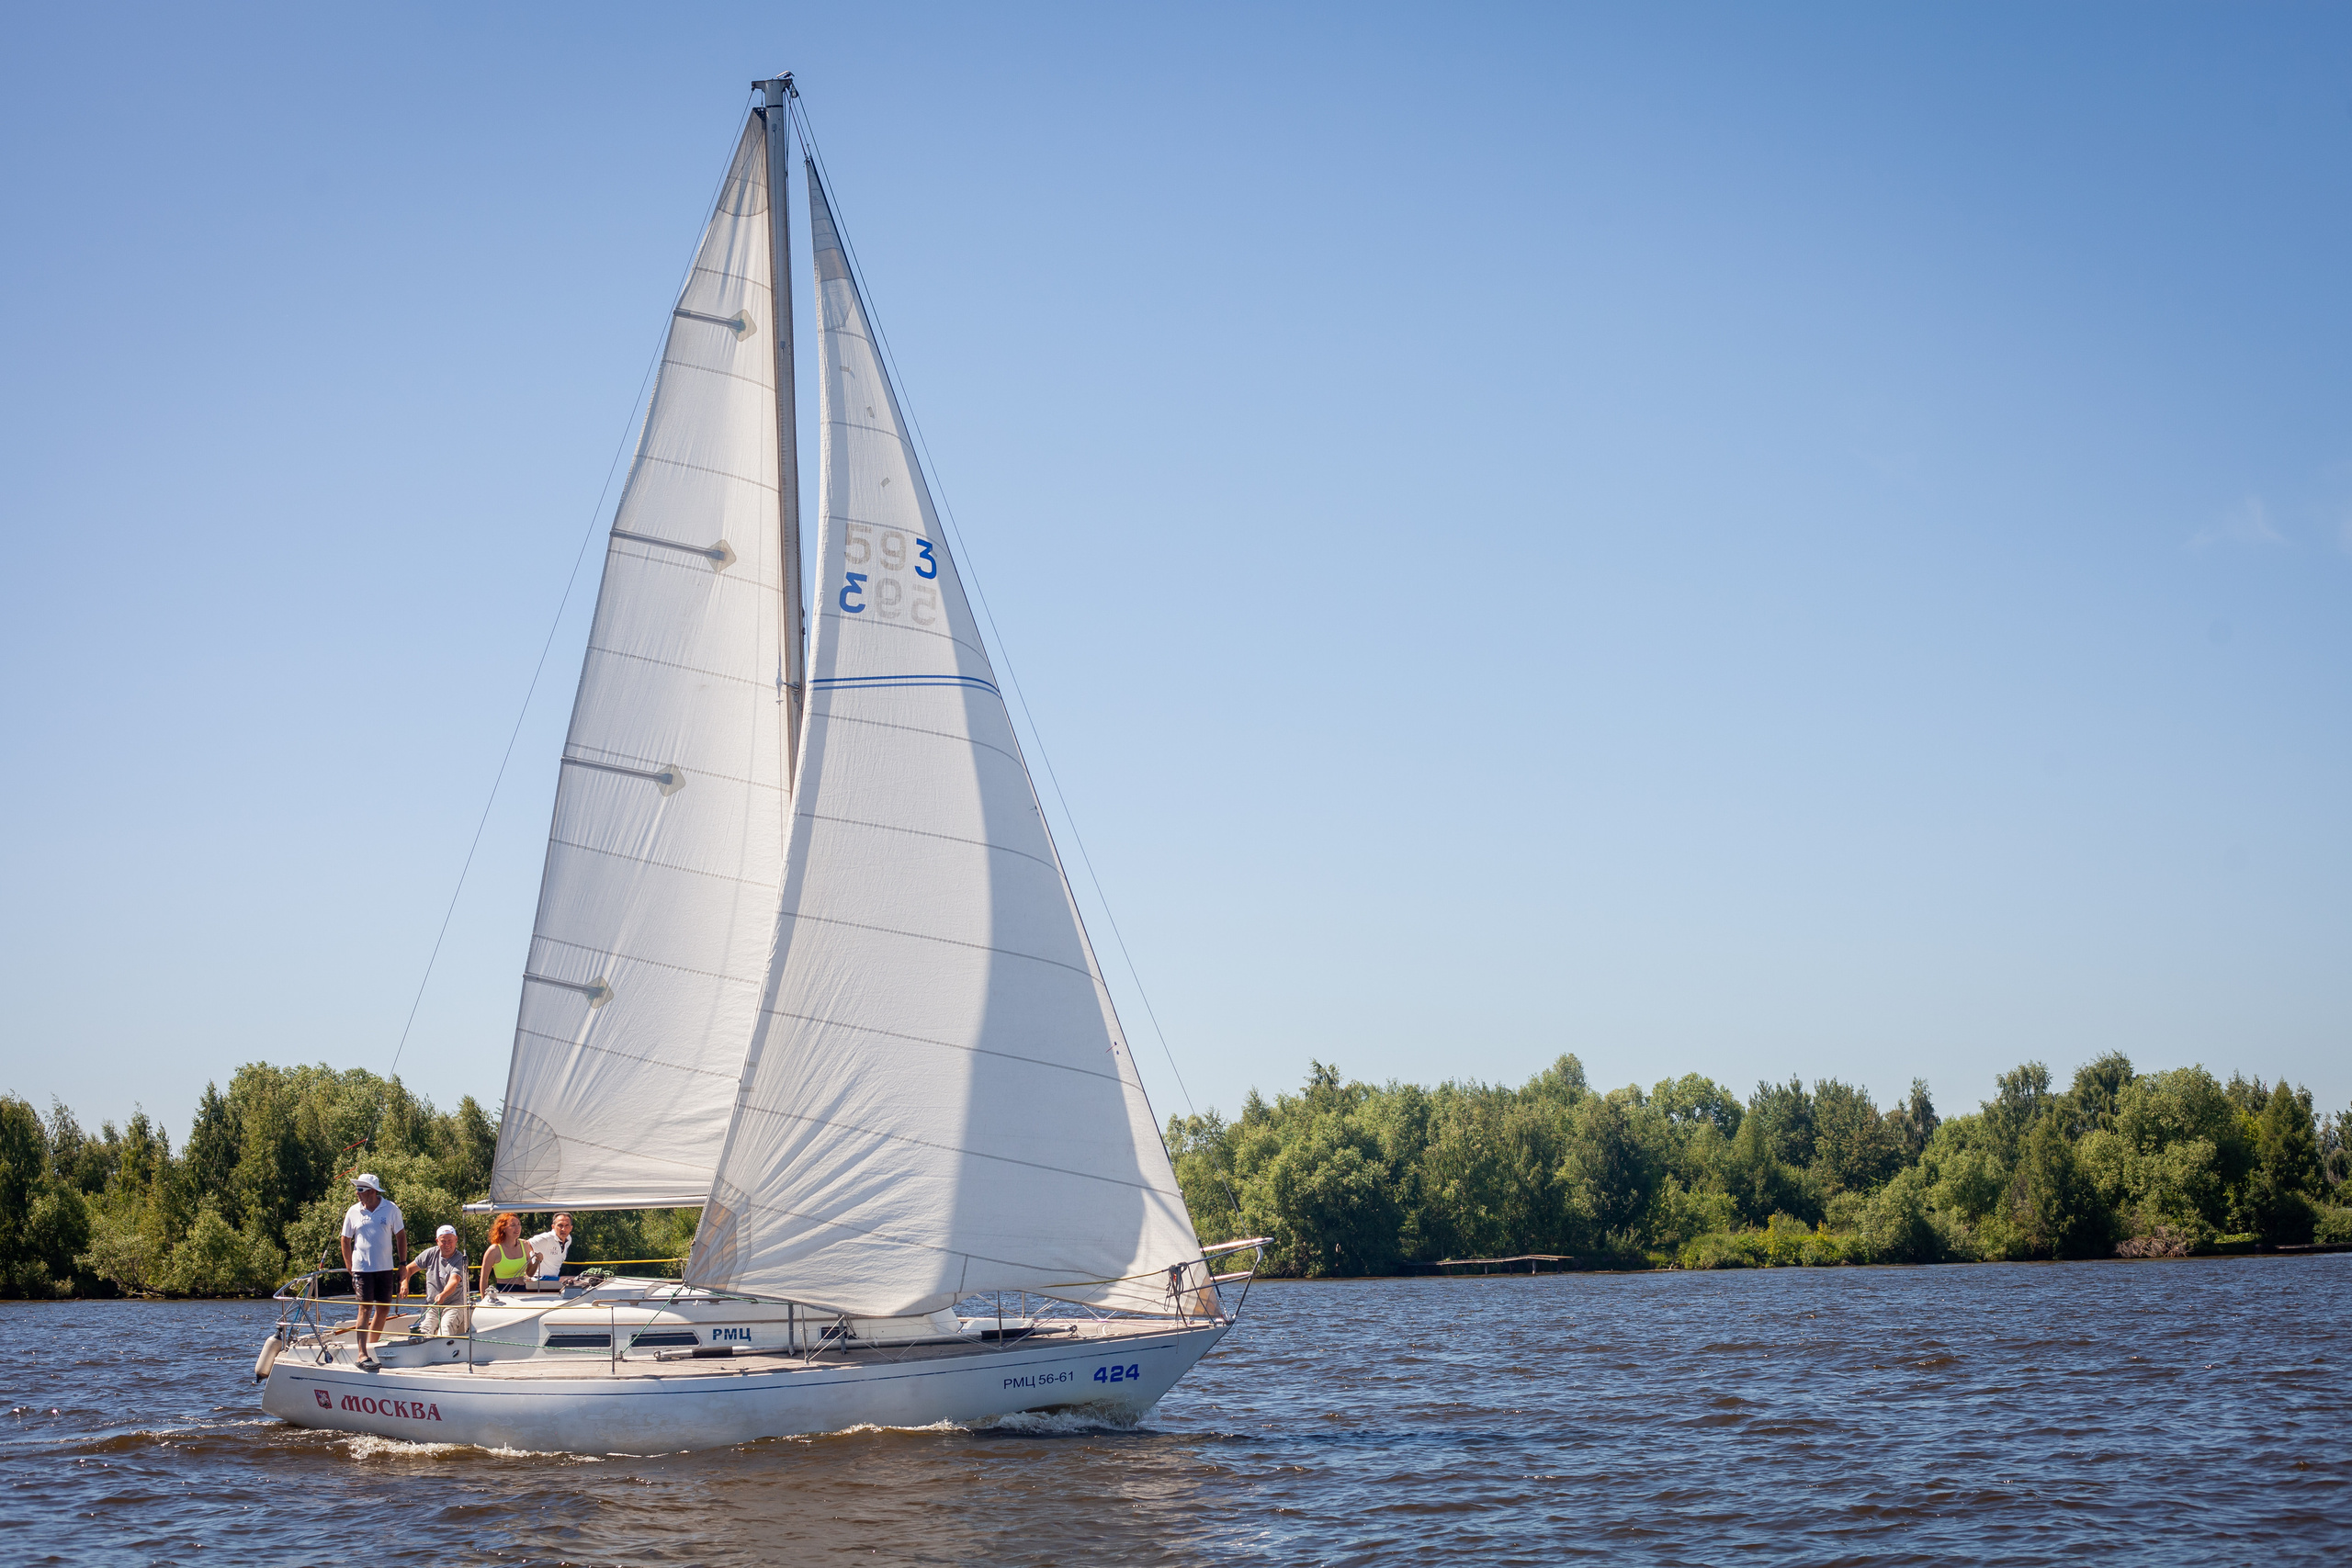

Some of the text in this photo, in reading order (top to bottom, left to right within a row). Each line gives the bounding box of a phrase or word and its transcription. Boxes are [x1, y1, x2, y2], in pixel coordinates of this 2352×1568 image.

[844, 523, 937, 580] 593
[712, 1327, 752, 1341] РМЦ
[1003, 1371, 1073, 1389] РМЦ 56-61
[1093, 1363, 1140, 1383] 424
[341, 1394, 443, 1421] МОСКВА
